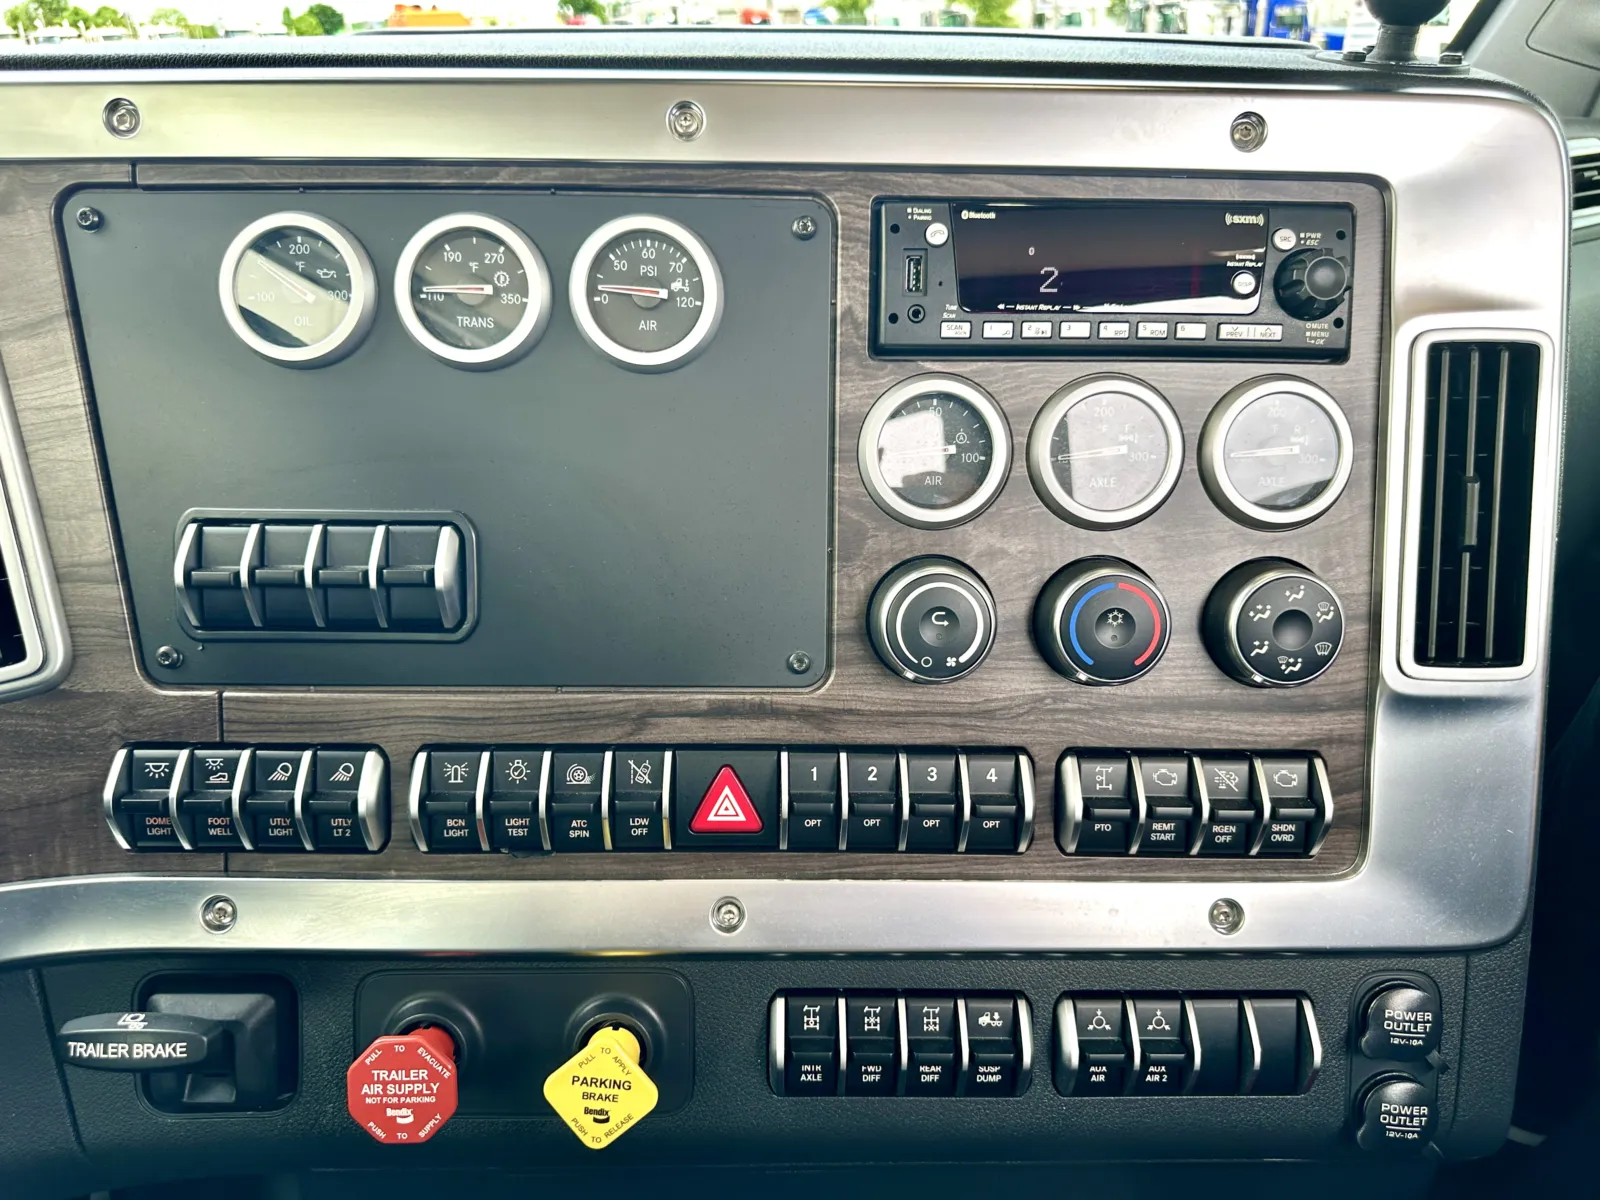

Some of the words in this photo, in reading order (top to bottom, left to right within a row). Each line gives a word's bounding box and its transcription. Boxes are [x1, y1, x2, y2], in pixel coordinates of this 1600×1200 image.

[968, 211, 996, 219] Bluetooth
[289, 244, 310, 255] 200
[641, 248, 656, 259] 60
[444, 252, 462, 263] 190
[484, 253, 505, 264] 270
[613, 260, 628, 271] 50
[669, 262, 683, 273] 70
[640, 265, 658, 277] PSI
[1040, 266, 1058, 292] 2
[256, 292, 275, 302] 100
[327, 290, 348, 301] 300
[500, 294, 521, 304] 350
[601, 294, 609, 304] 0
[676, 297, 695, 308] 120
[294, 316, 313, 327] OIL
[457, 316, 494, 328] TRANS
[638, 320, 658, 331] AIR
[929, 407, 942, 417] 50
[1094, 407, 1115, 417] 200
[1267, 407, 1286, 417] 200
[961, 453, 979, 463] 100
[1129, 452, 1149, 462] 300
[924, 476, 942, 486] AIR
[1089, 477, 1117, 488] AXLE
[1258, 477, 1286, 486] AXLE
[810, 767, 818, 781] 1
[867, 766, 878, 781] 2
[927, 767, 938, 782] 3
[986, 768, 998, 782] 4
[208, 818, 230, 826] FOOT
[270, 818, 290, 826] UTLY
[331, 818, 352, 826] UTLY
[447, 819, 465, 827] BCN
[505, 818, 530, 826] LIGHT
[571, 820, 587, 828] ATC
[630, 818, 649, 826] LDW
[804, 819, 822, 827] OPT
[863, 819, 881, 827] OPT
[922, 820, 940, 828] OPT
[982, 821, 1000, 829] OPT
[1152, 823, 1175, 831] REMT
[147, 827, 171, 836] LIGHT
[208, 828, 233, 836] WELL
[269, 828, 293, 836] LIGHT
[334, 829, 344, 837] LT
[345, 829, 351, 837] 2
[444, 829, 469, 837] LIGHT
[508, 828, 528, 837] TEST
[631, 828, 648, 836] OFF
[1094, 824, 1112, 832] PTO
[1212, 825, 1236, 833] RGEN
[1271, 824, 1295, 832] SHDN
[569, 830, 590, 838] SPIN
[1150, 833, 1176, 841] START
[1215, 835, 1232, 843] OFF
[1271, 834, 1294, 842] OVRD
[1384, 1009, 1432, 1022] POWER
[1384, 1020, 1432, 1032] OUTLET
[1390, 1037, 1424, 1046] 12V-10A
[68, 1042, 129, 1058] TRAILER
[133, 1042, 188, 1058] BRAKE
[364, 1048, 382, 1066] PULL
[417, 1047, 451, 1079] EVACUATE
[578, 1054, 596, 1069] PULL
[600, 1047, 612, 1055] TO
[612, 1055, 632, 1076] APPLY
[371, 1070, 428, 1081] TRAILER
[800, 1074, 822, 1082] AXLE
[862, 1074, 881, 1082] DIFF
[921, 1074, 940, 1082] DIFF
[976, 1074, 1002, 1082] DUMP
[1090, 1074, 1105, 1082] AIR
[1145, 1074, 1160, 1082] AIR
[1161, 1074, 1167, 1082] 2
[571, 1075, 632, 1091] PARKING
[361, 1084, 383, 1095] AIR
[386, 1083, 440, 1094] SUPPLY
[400, 1096, 436, 1104] PARKING
[582, 1091, 619, 1103] BRAKE
[386, 1108, 412, 1117] Bendix
[583, 1106, 610, 1116] Bendix
[1381, 1103, 1428, 1116] POWER
[1380, 1114, 1427, 1126] OUTLET
[367, 1121, 387, 1139] PUSH
[418, 1113, 442, 1138] SUPPLY
[571, 1117, 588, 1136] PUSH
[603, 1113, 634, 1139] RELEASE
[1385, 1130, 1418, 1139] 12V-10A
